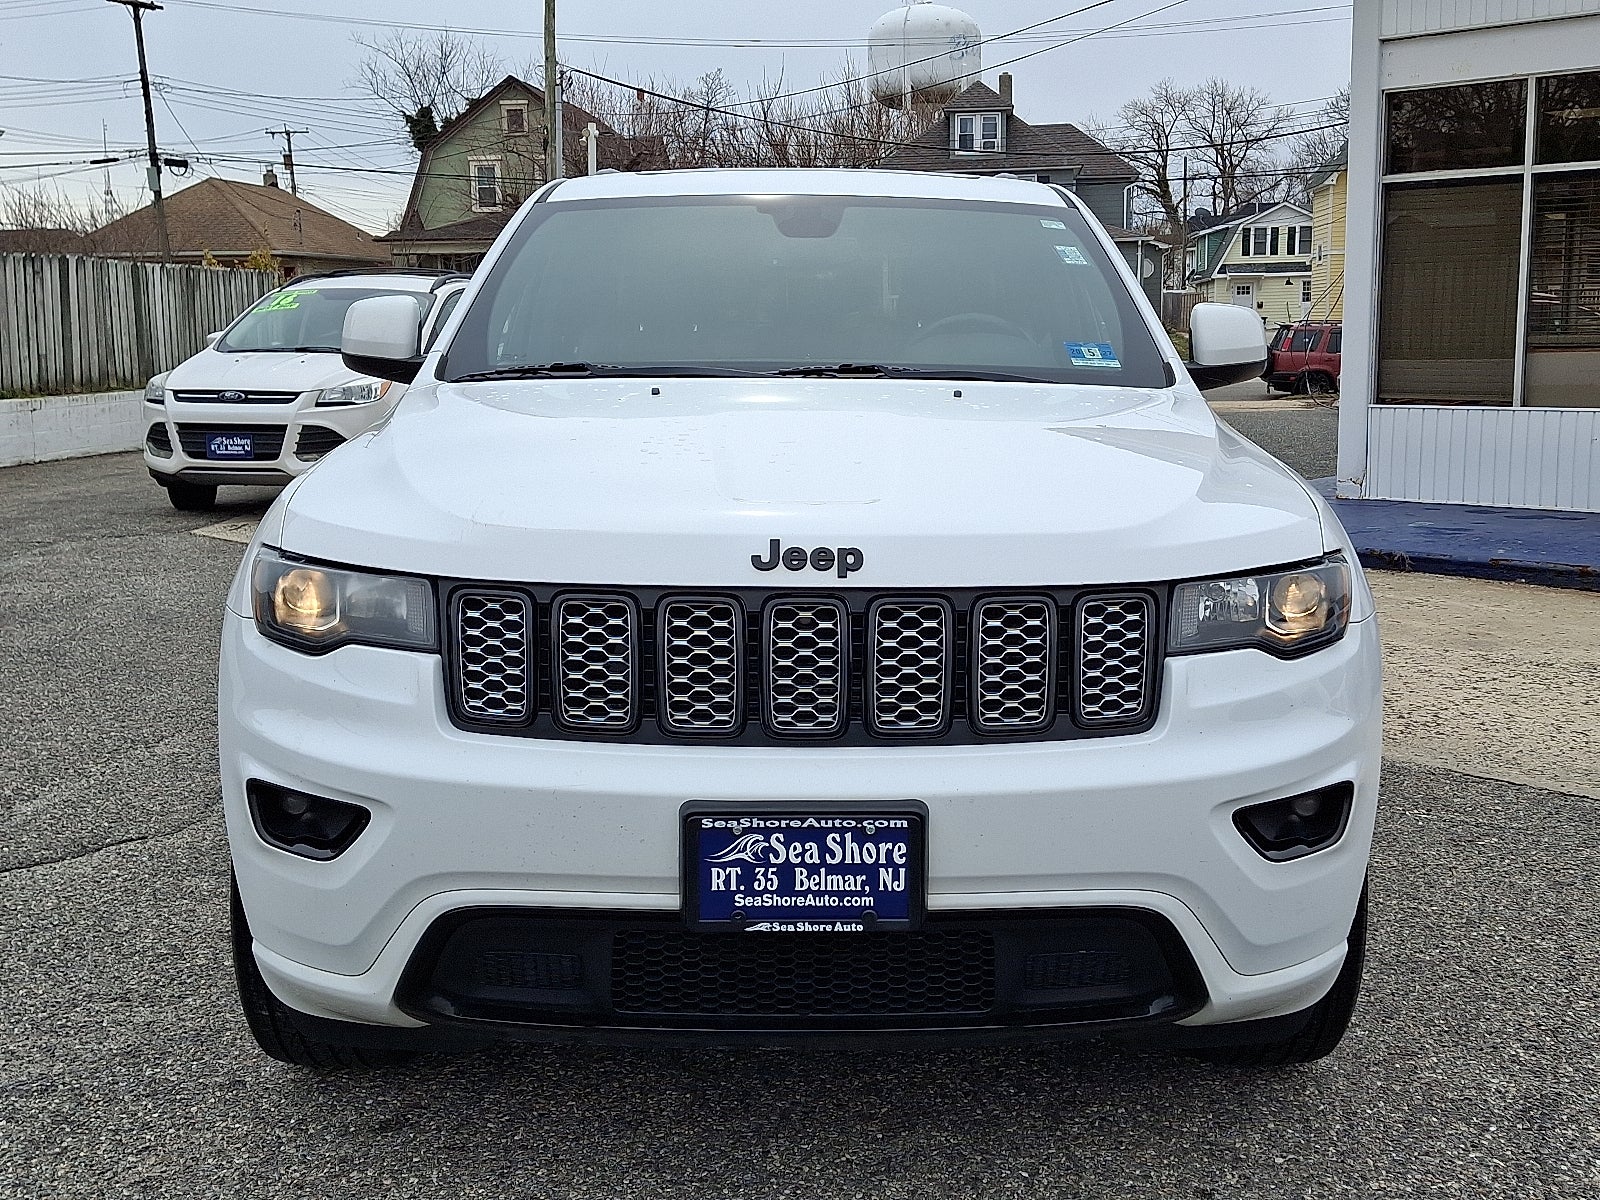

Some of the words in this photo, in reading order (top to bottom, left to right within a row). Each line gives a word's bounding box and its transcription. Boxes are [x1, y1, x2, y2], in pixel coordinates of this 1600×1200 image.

[1087, 348, 1096, 357] 5
[750, 538, 864, 578] Jeep
[701, 817, 908, 829] SeaShoreAuto.com
[769, 832, 820, 864] Sea
[825, 831, 907, 864] Shore
[710, 867, 745, 891] RT.
[753, 867, 779, 891] 35
[794, 867, 870, 895] Belmar,
[878, 867, 906, 892] NJ
[734, 894, 874, 907] SeaShoreAuto.com
[771, 922, 796, 932] Sea
[797, 922, 833, 932] Shore
[833, 922, 864, 932] Auto
